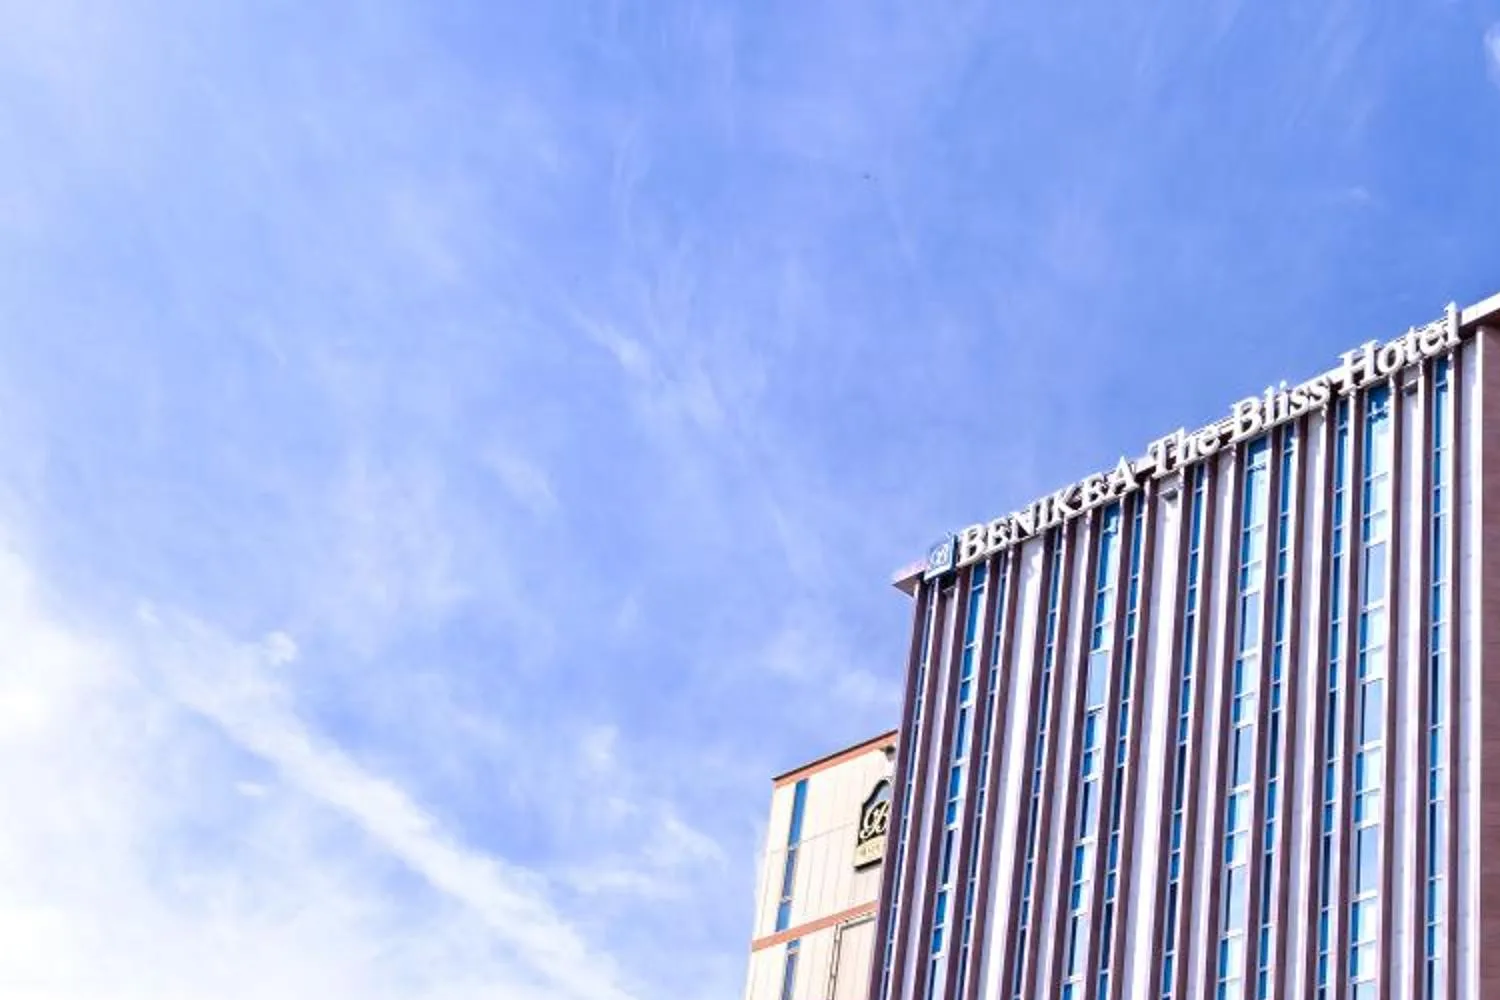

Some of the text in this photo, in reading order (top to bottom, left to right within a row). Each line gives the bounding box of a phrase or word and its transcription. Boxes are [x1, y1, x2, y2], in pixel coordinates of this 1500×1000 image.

[955, 301, 1463, 564] BENIKEA The Bliss Hotel
